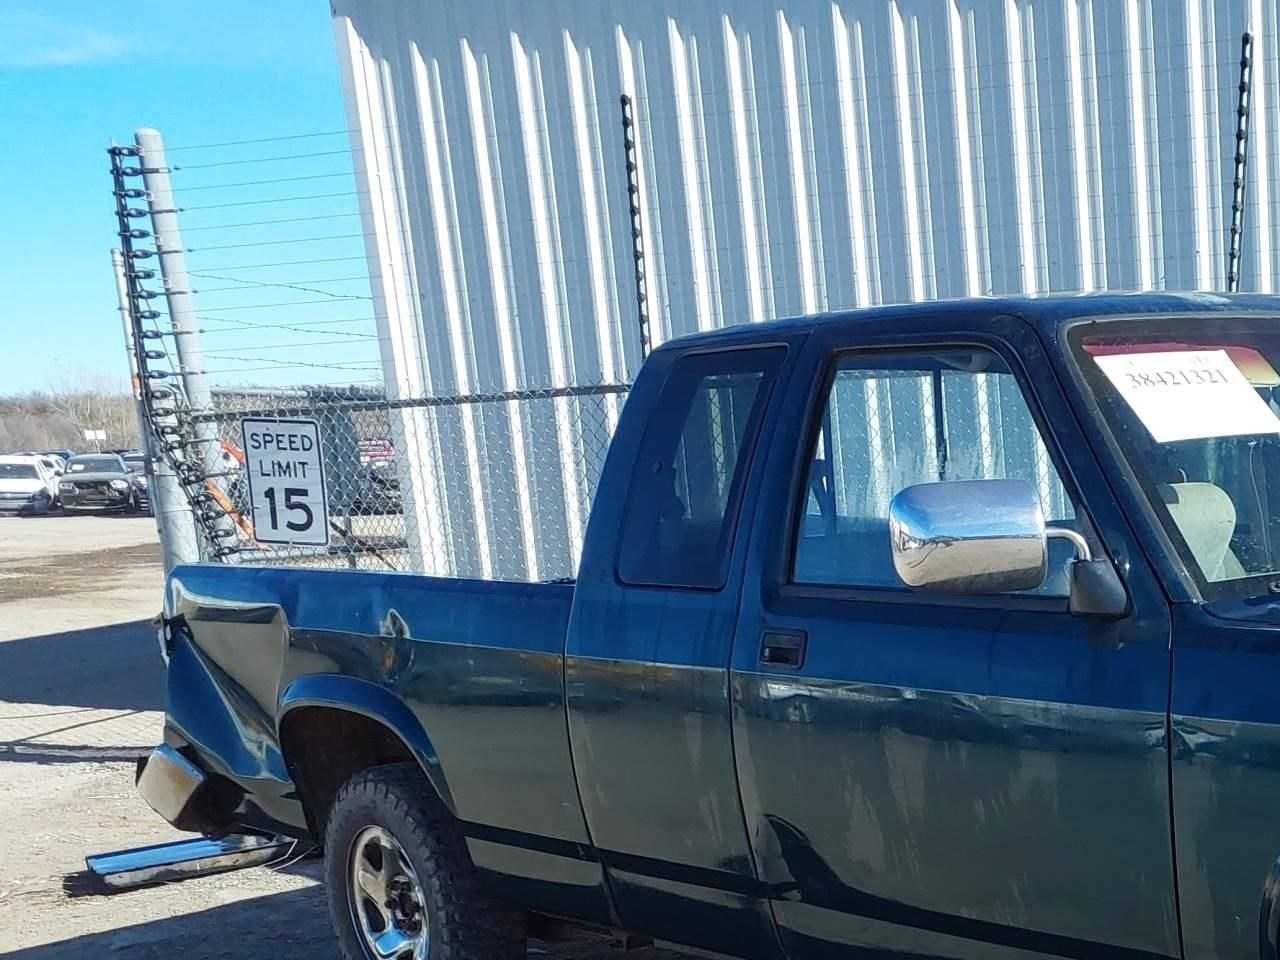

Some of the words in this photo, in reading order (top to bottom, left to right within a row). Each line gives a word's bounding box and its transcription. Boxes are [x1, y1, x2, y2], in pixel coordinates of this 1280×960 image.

[1126, 369, 1229, 388] 38421321
[250, 433, 313, 452] SPEED
[259, 460, 309, 479] LIMIT
[264, 487, 313, 532] 15
